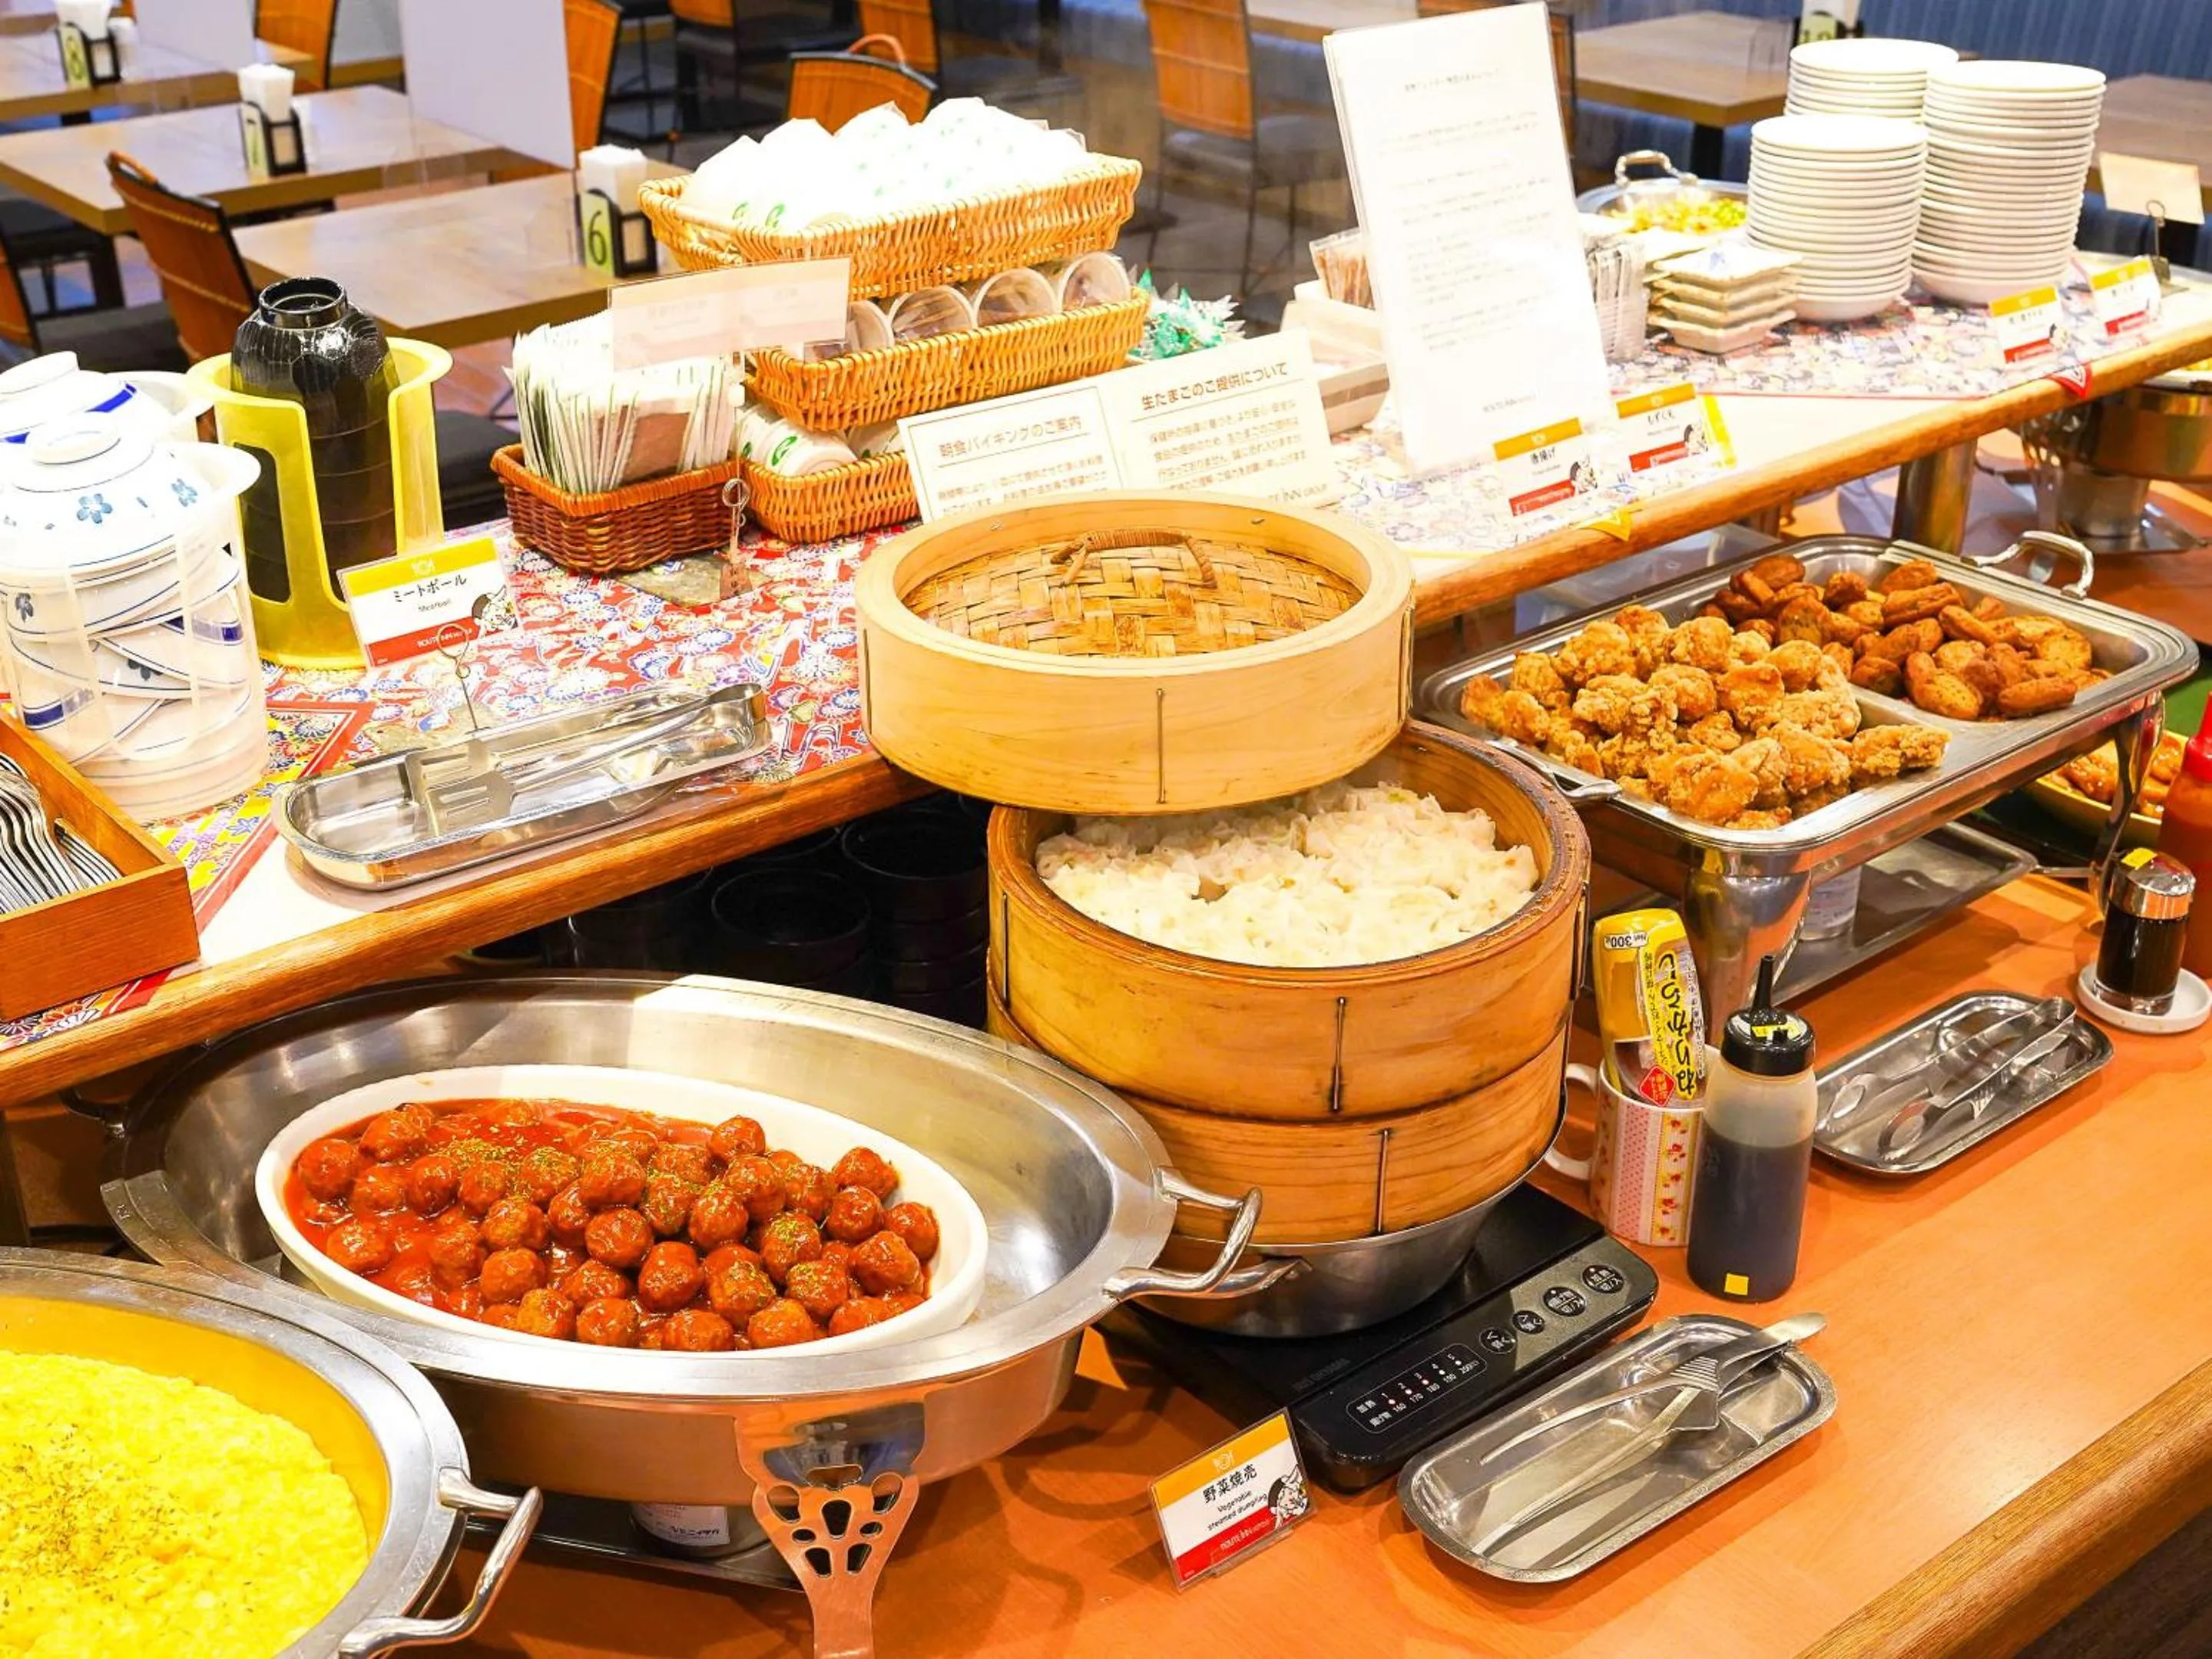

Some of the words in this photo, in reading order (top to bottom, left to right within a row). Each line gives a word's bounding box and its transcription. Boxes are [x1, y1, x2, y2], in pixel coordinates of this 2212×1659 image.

[588, 210, 608, 265] 6
[1141, 362, 1288, 411] 生たまごのご提供について
[939, 416, 1082, 458] 朝食バイキングのご案内
[393, 575, 467, 602] ミートボール
[1658, 953, 1695, 1095] ねりからし
[1203, 1463, 1257, 1503] 野菜焼売
[1217, 1490, 1253, 1512] Vegetable
[1207, 1511, 1237, 1531] steamed
